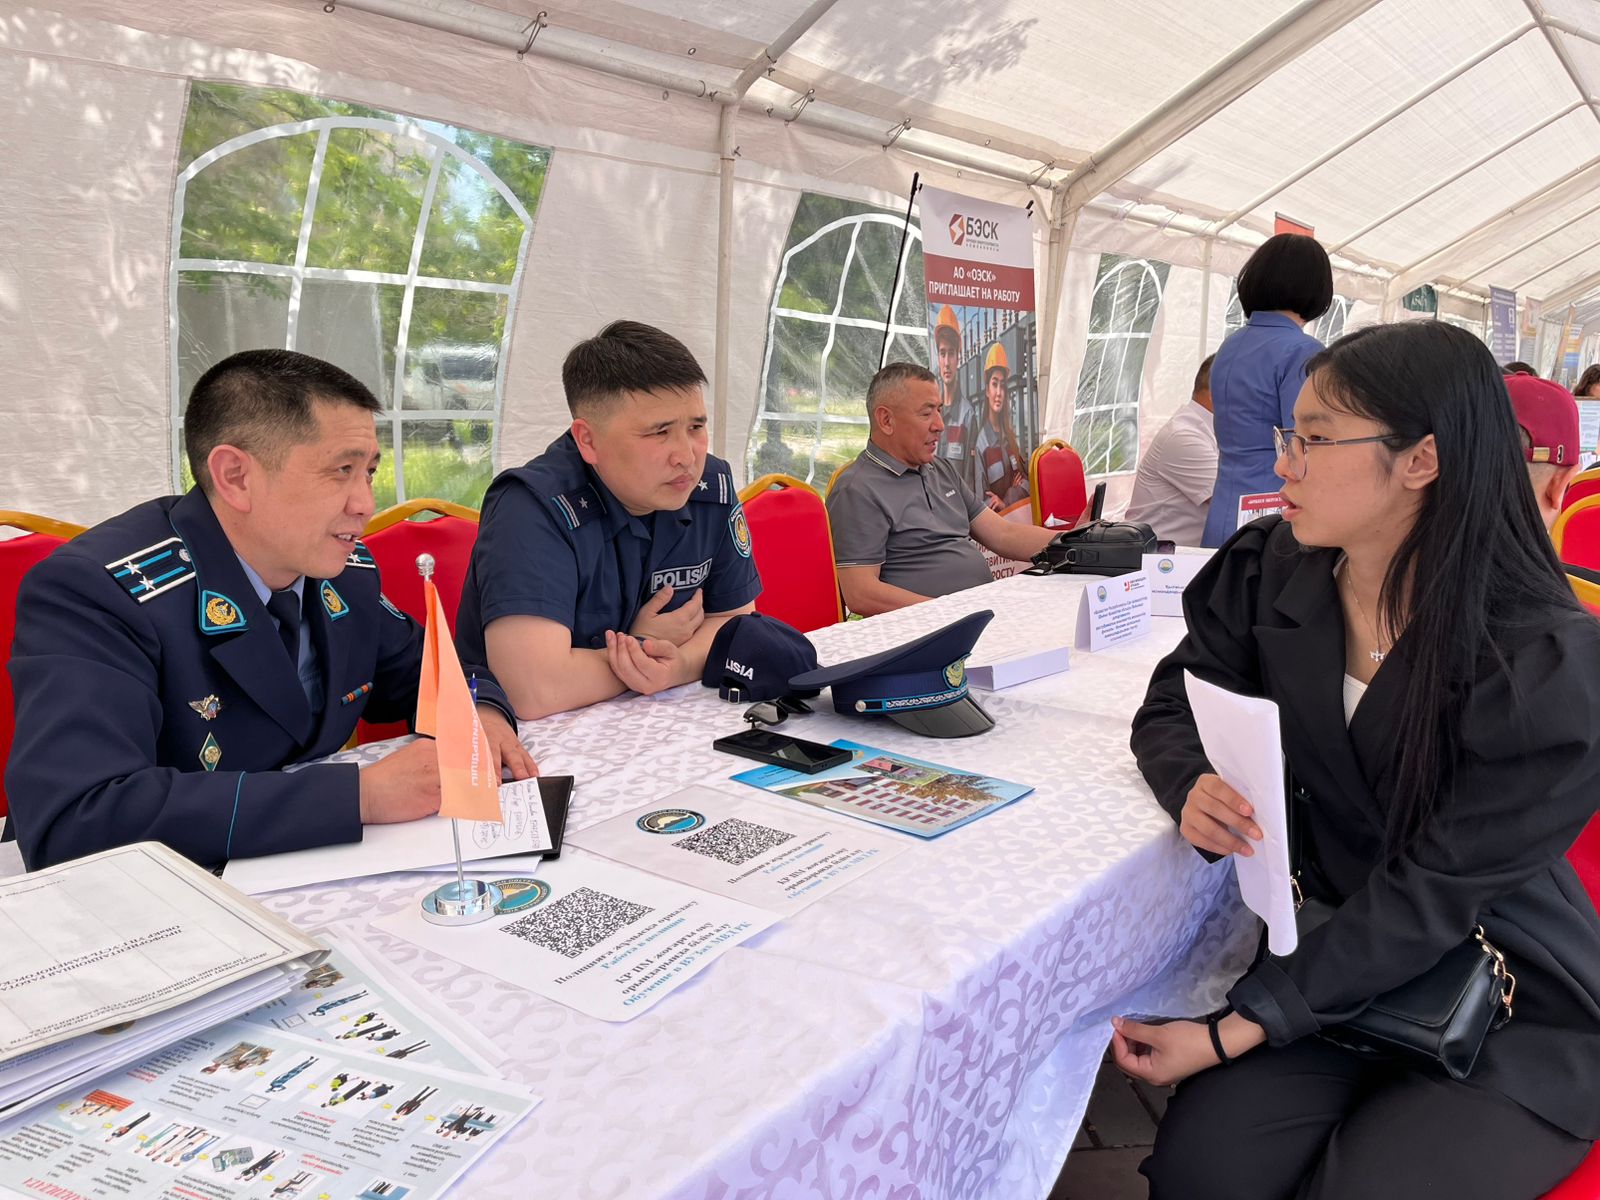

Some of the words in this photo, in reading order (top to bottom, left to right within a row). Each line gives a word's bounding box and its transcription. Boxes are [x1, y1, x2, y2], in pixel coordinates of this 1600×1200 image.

[966, 217, 998, 241] БЭСК
[953, 266, 964, 279] АО
[966, 269, 996, 282] «ОЭСК»
[929, 281, 980, 299] ПРИГЛАШАЕТ
[981, 288, 992, 300] НА
[993, 290, 1020, 303] РАБОТУ
[653, 562, 710, 590] POLISIA
[725, 657, 754, 681] LISIA
[47, 929, 183, 978] ПРОФОРИЕНТАЦИОННАЯ
[601, 945, 638, 970] Работа
[0, 974, 46, 991] РАБОТА
[622, 972, 674, 1007] Обучение
